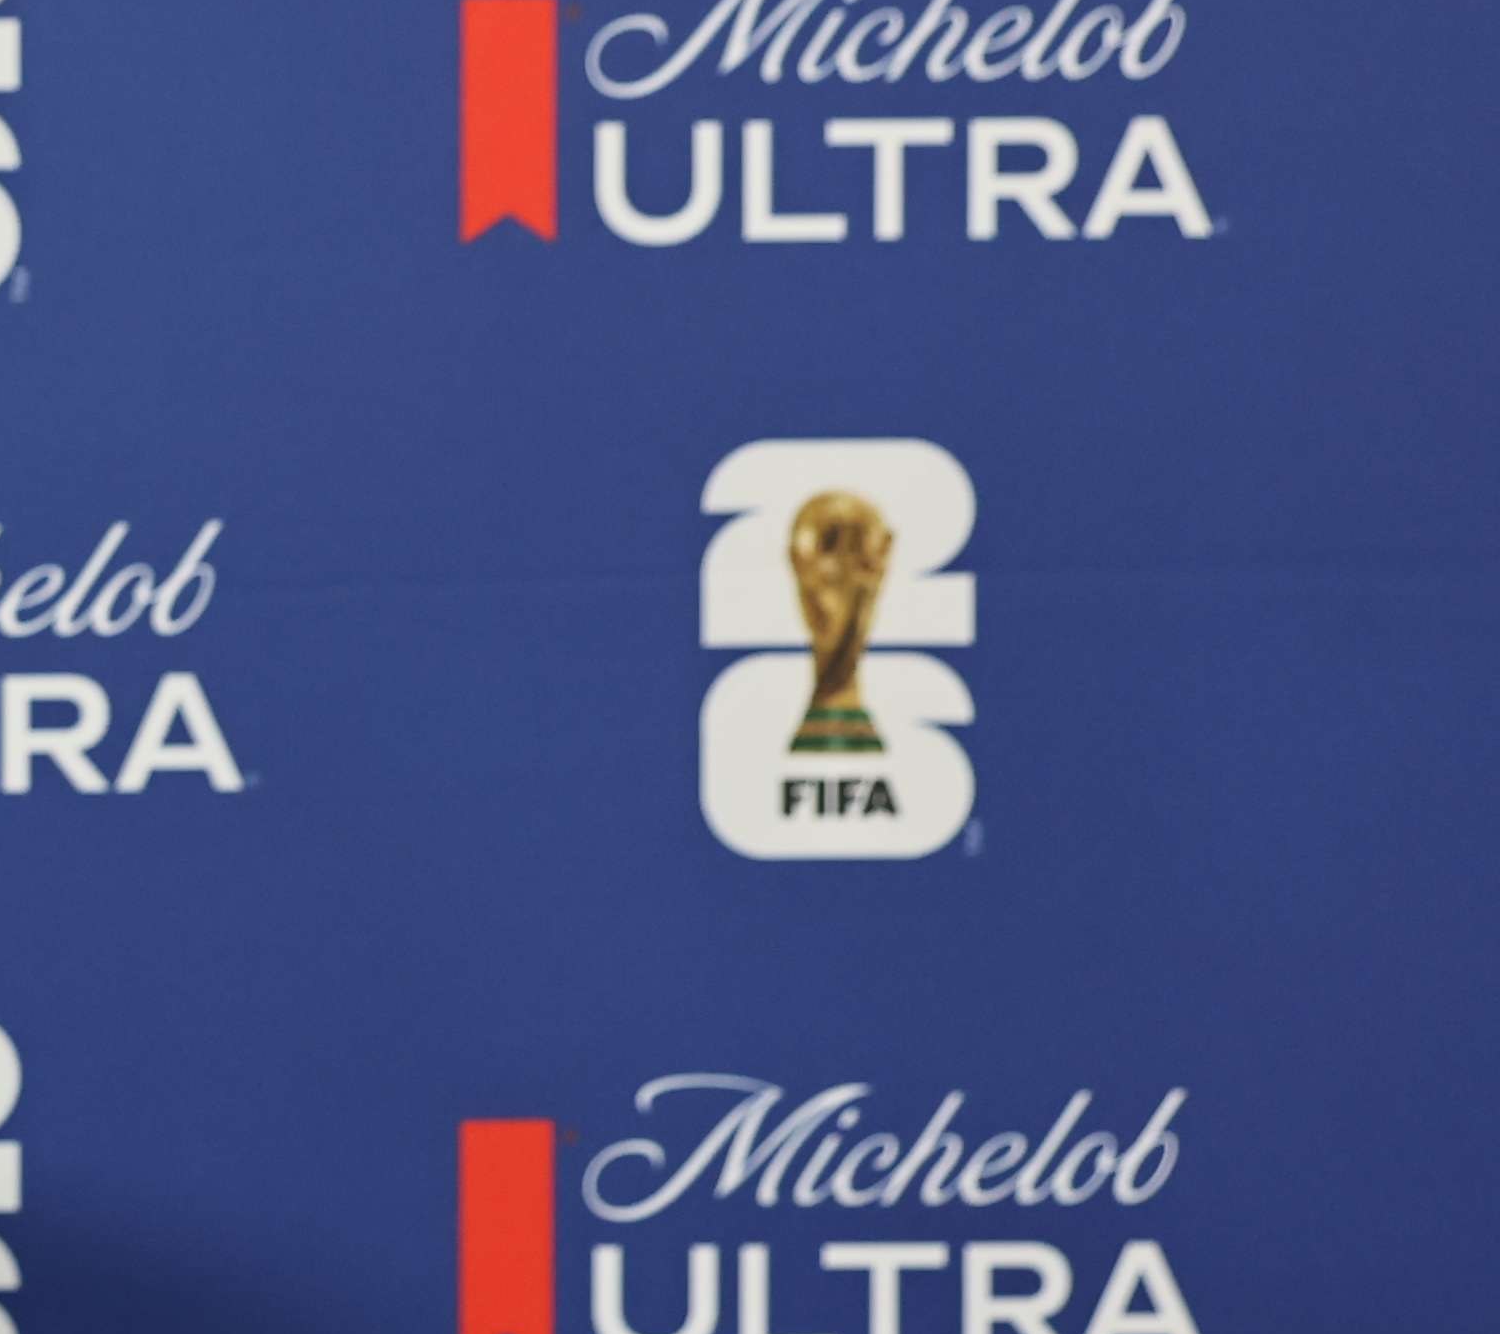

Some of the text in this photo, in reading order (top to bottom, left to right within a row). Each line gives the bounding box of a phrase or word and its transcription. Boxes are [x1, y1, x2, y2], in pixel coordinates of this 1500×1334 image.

[592, 113, 1215, 248] ULTRA
[780, 776, 899, 819] FIFA
[581, 1072, 1187, 1224] Michelob
